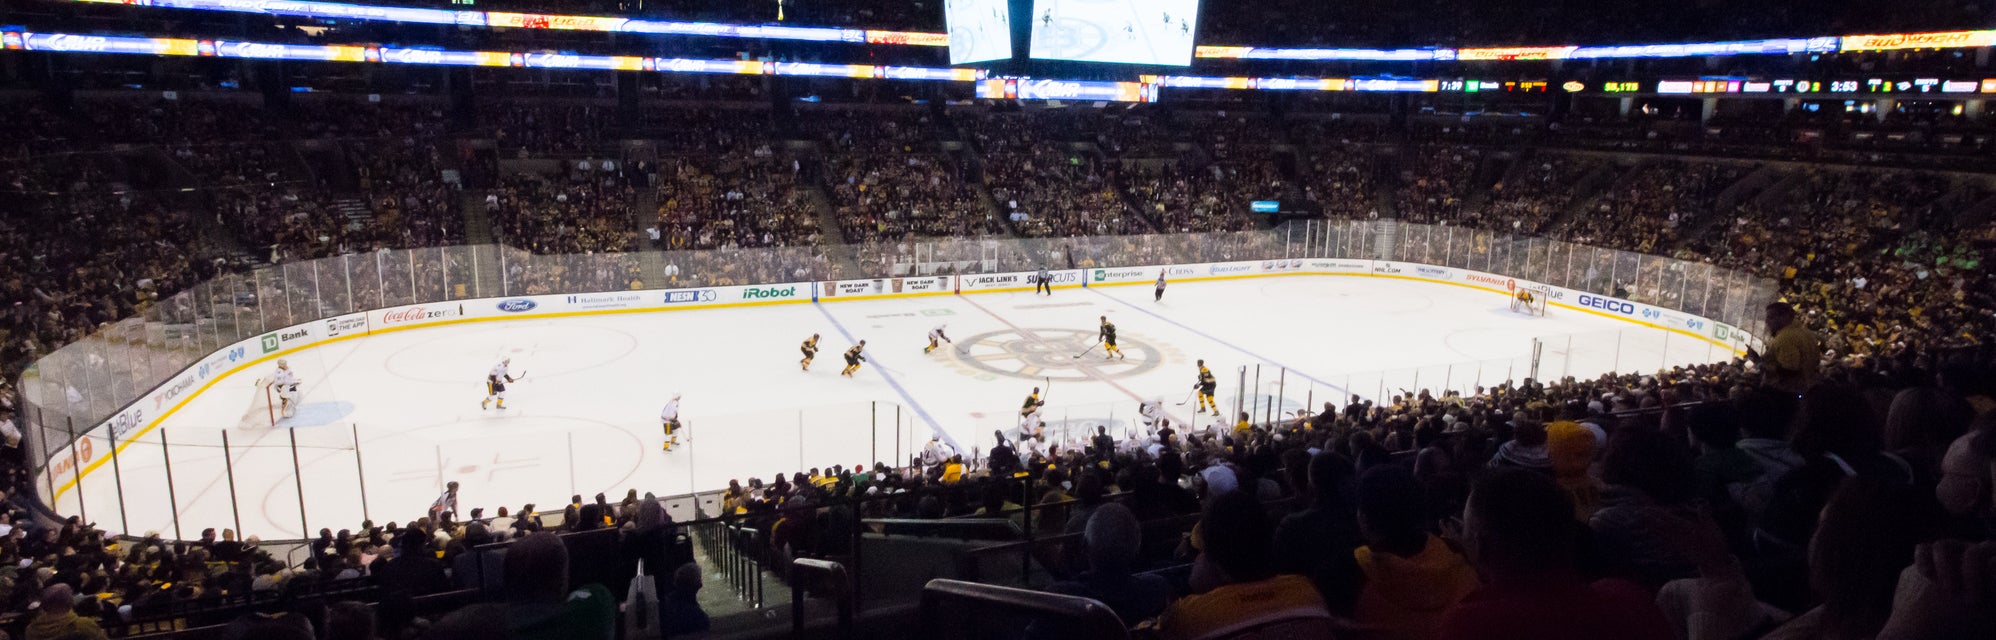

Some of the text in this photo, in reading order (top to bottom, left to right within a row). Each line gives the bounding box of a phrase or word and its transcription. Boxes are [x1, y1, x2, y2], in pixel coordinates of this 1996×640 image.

[979, 276, 995, 284] JACK
[1026, 271, 1077, 285] SURCUTS
[1465, 273, 1506, 287] SYLVANIA
[669, 291, 695, 302] NESN
[743, 286, 796, 299] iRobot
[1578, 294, 1635, 315] GEICO
[262, 328, 308, 351] TD Bank
